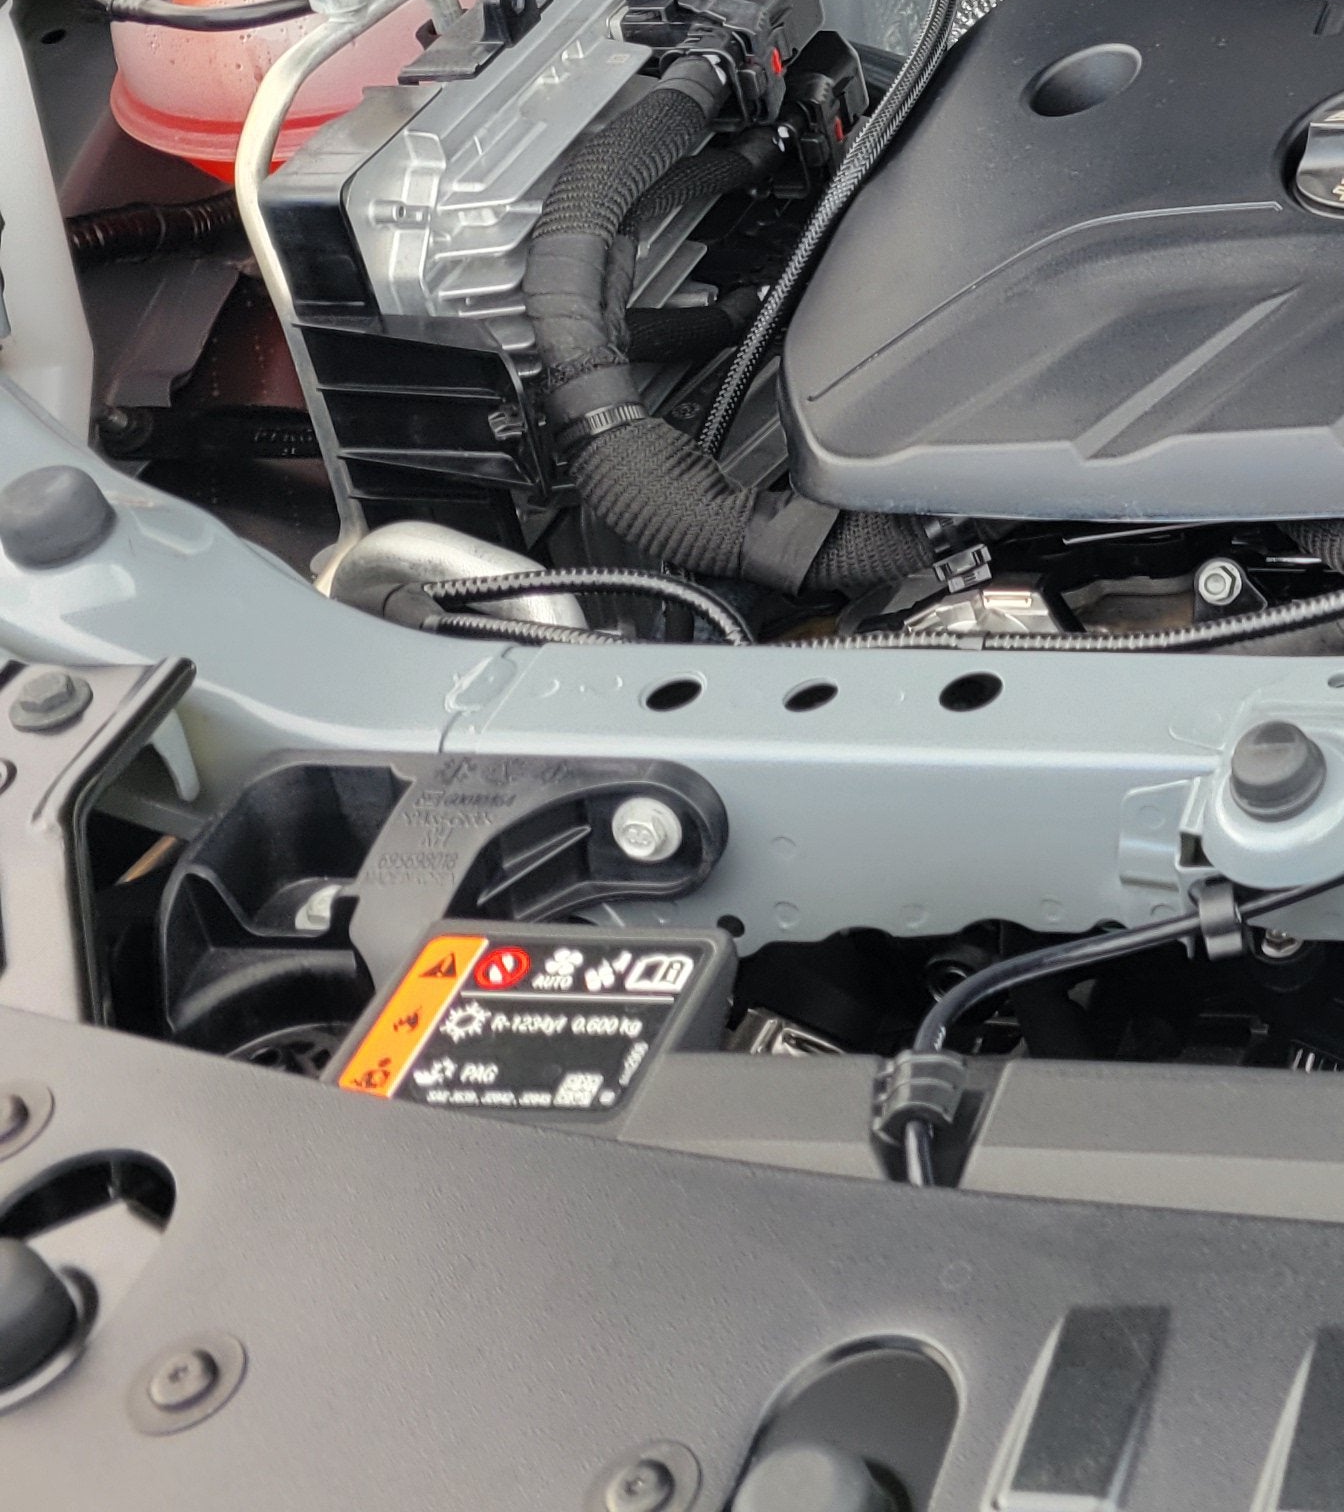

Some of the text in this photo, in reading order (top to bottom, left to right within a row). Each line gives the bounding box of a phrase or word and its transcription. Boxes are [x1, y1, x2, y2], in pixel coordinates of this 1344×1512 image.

[532, 974, 573, 990] AUTO
[571, 1014, 619, 1035] 0.600
[619, 1016, 643, 1038] kg
[460, 1062, 499, 1085] PAG
